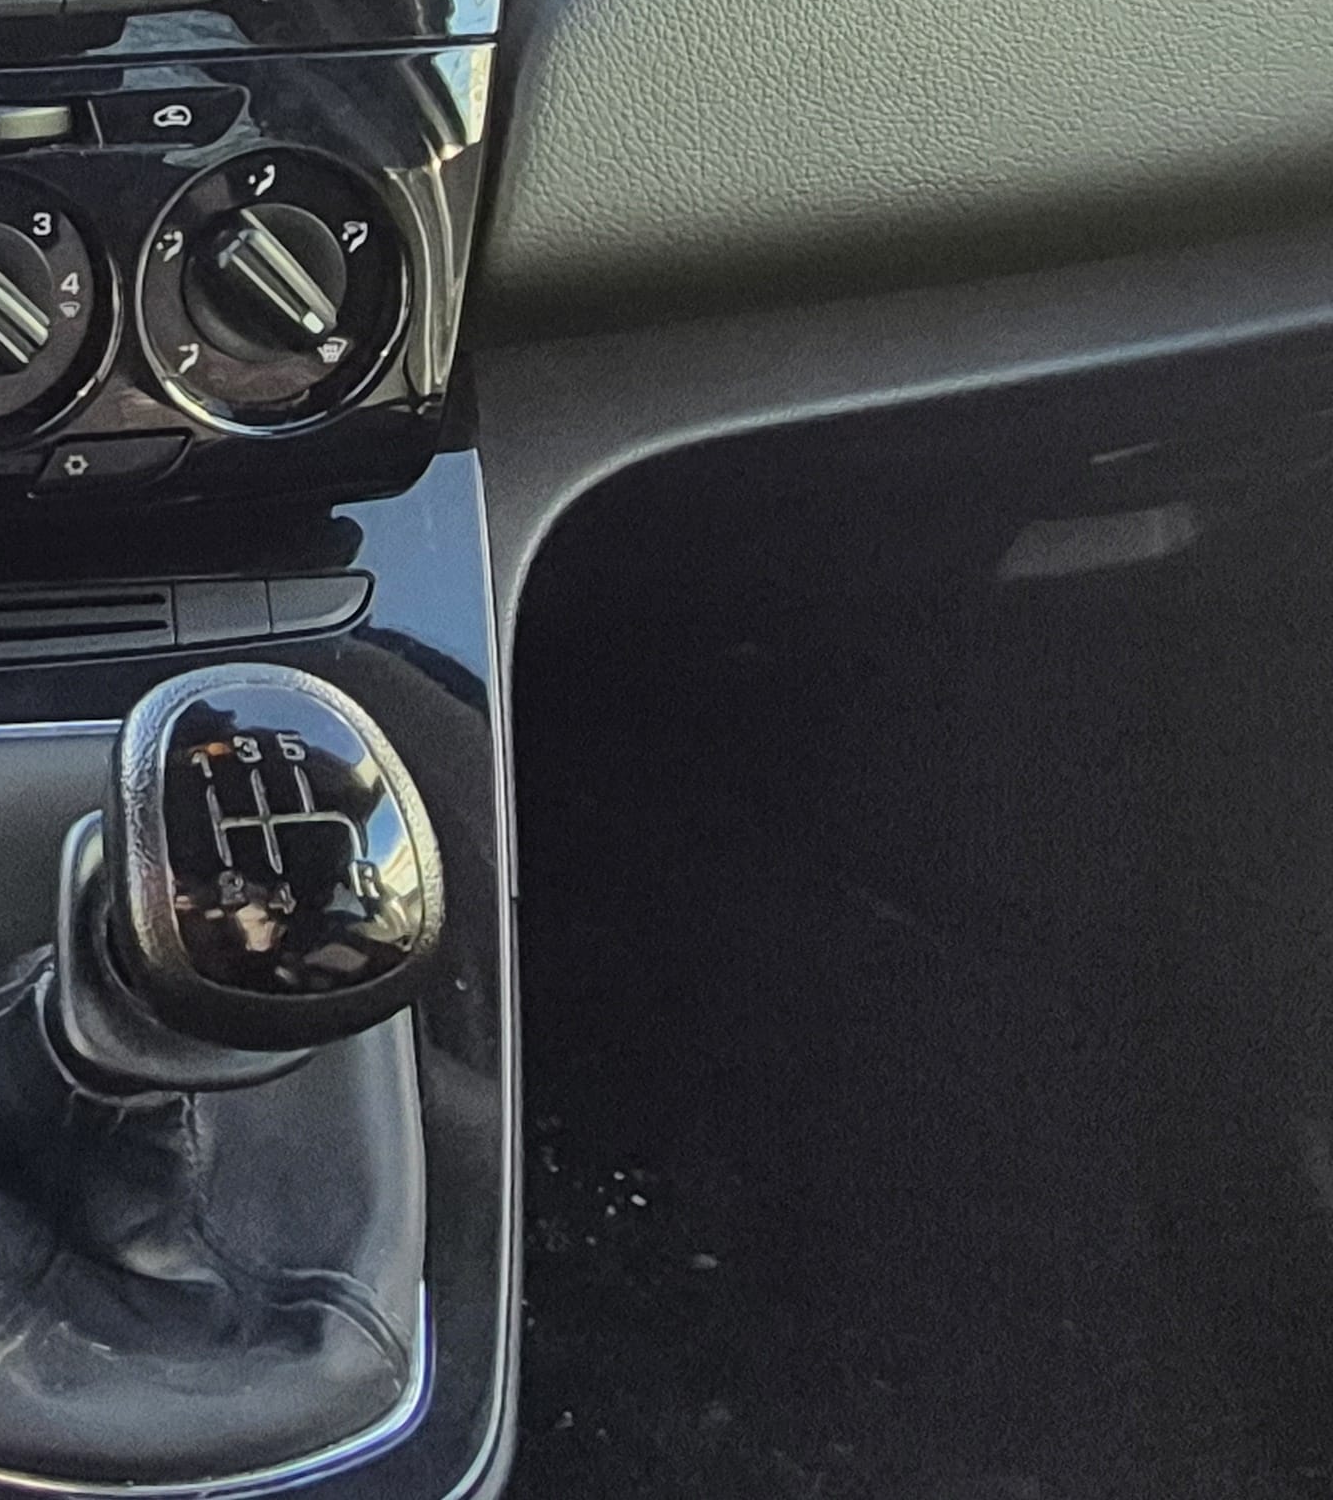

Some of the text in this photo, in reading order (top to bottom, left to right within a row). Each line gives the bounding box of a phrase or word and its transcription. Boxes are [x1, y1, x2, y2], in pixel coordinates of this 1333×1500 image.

[32, 212, 53, 237] 3
[59, 272, 80, 296] 4
[233, 735, 263, 764] 3
[276, 732, 306, 762] 5
[191, 751, 213, 778] 1
[347, 861, 381, 898] R
